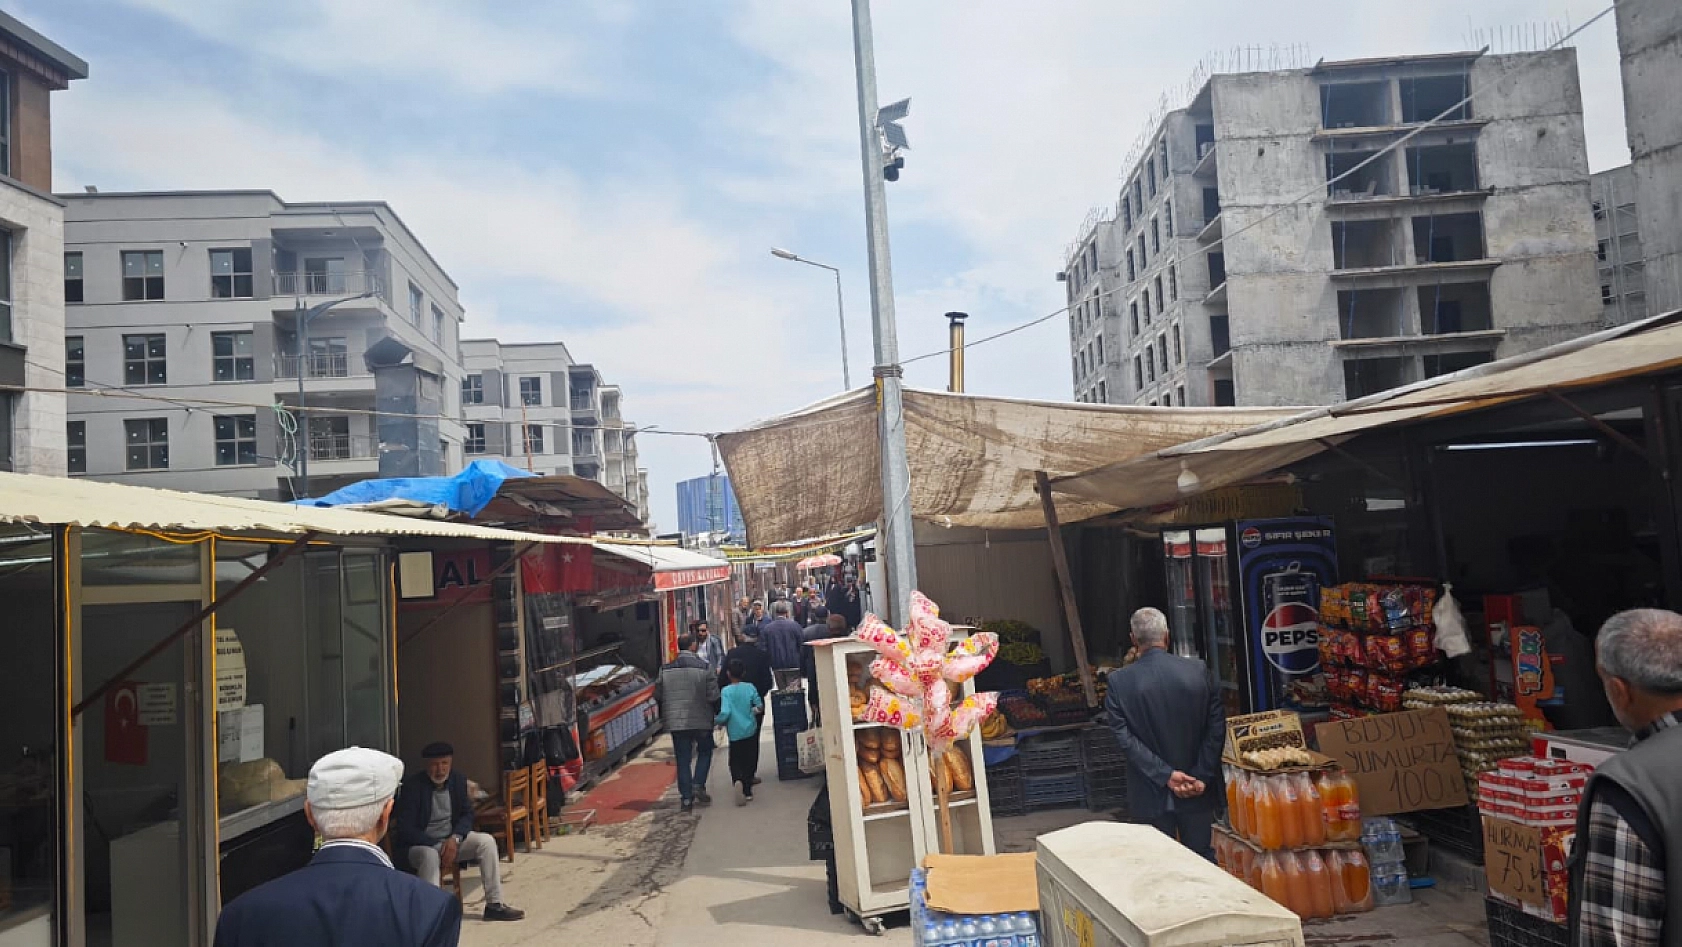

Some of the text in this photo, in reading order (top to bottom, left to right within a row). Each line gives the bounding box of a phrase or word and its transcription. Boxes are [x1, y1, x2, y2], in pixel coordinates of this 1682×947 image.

[1265, 629, 1320, 647] PEPS
[1344, 742, 1457, 774] YUMURTA
[1487, 823, 1538, 854] HURMA
